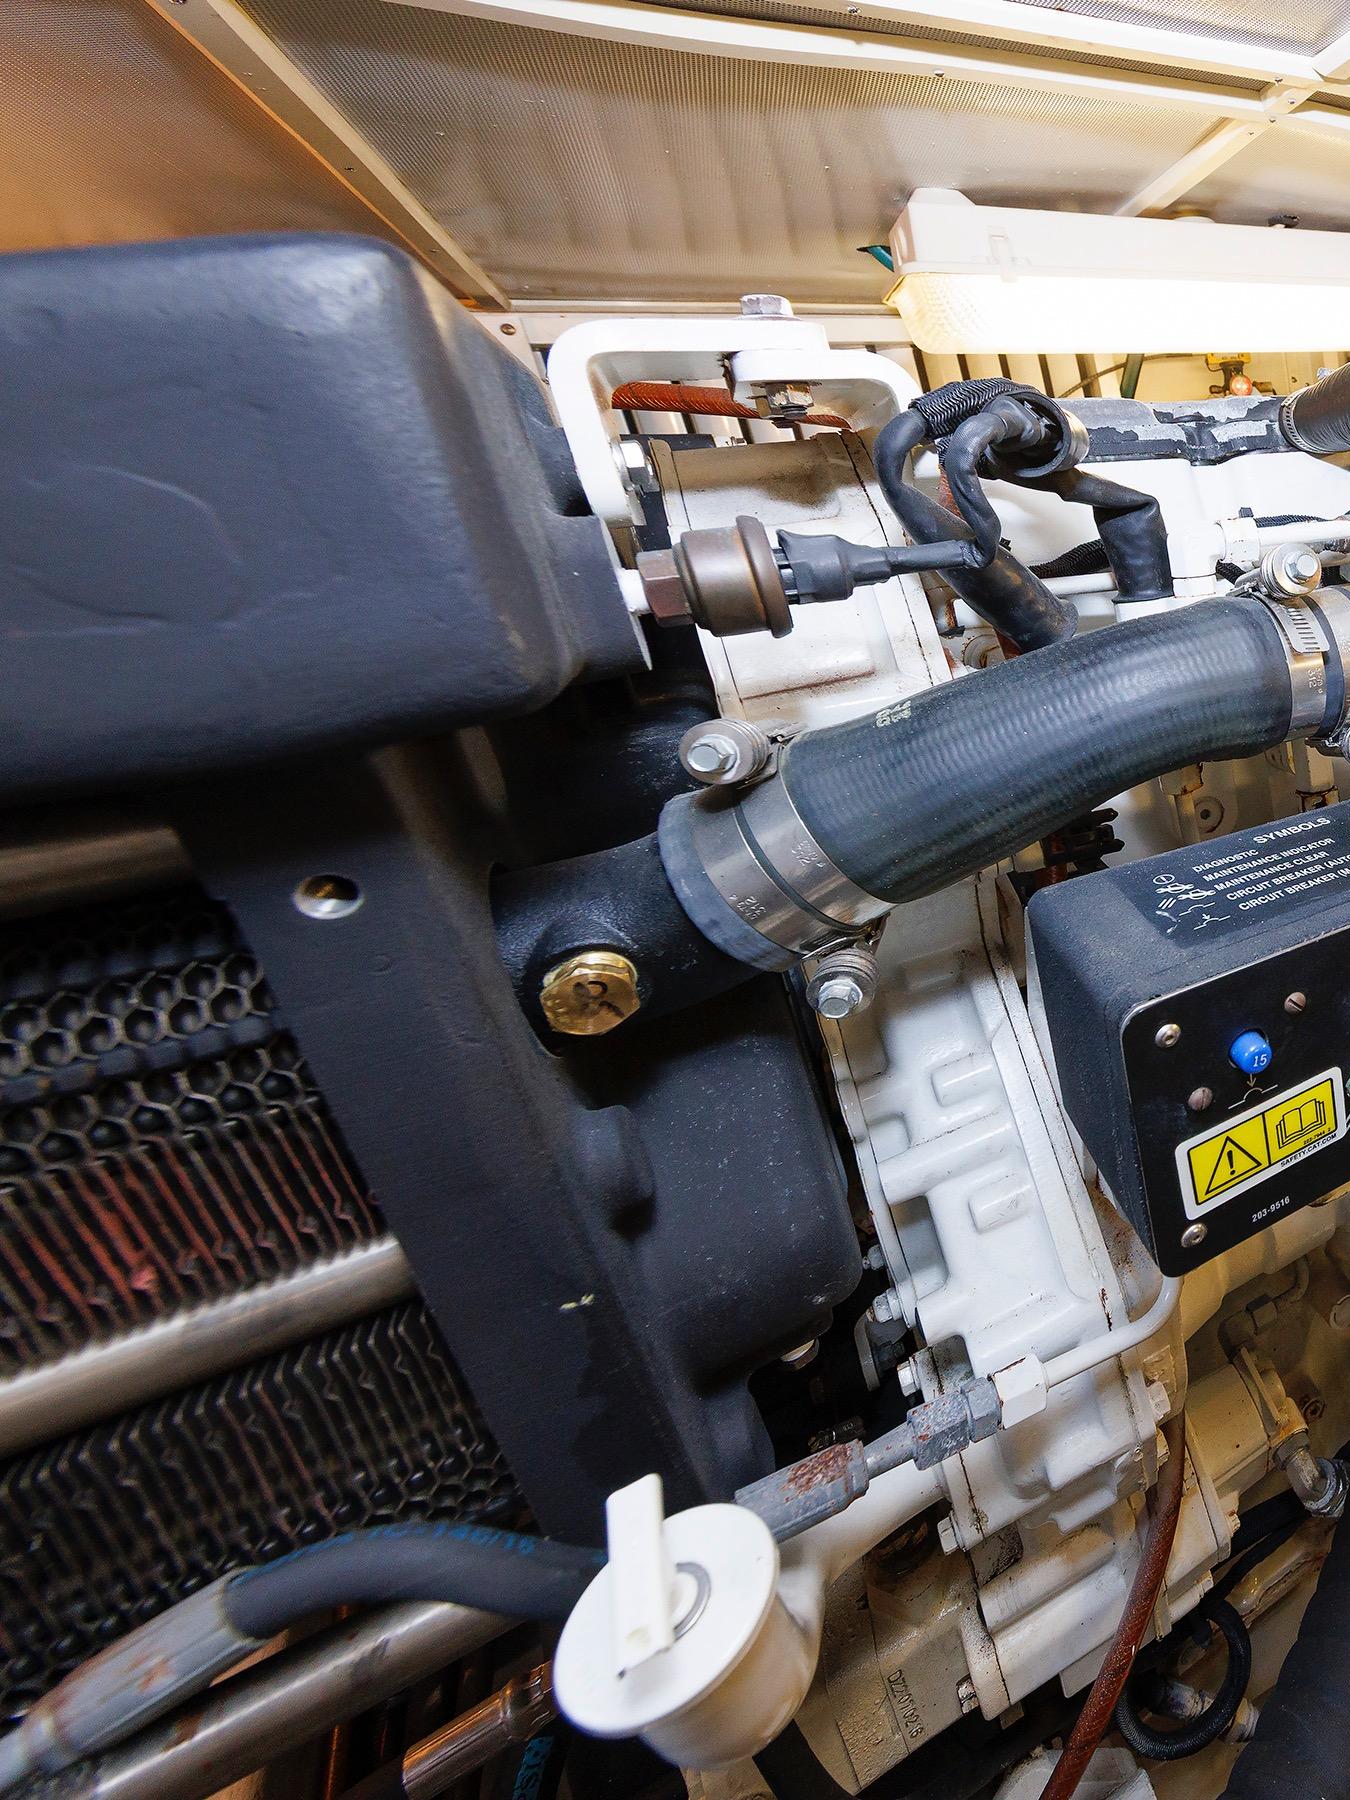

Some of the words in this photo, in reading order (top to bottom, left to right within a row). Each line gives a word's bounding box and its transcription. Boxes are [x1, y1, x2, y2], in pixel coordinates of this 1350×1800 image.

[1253, 817, 1331, 844] SYMBOLS
[1192, 849, 1259, 874] DIAGNOSTIC
[1202, 853, 1280, 882] MAINTENANCE
[1281, 837, 1336, 858] INDICATOR
[1213, 860, 1294, 892] MAINTENANCE
[1294, 851, 1330, 866] CLEAR
[1226, 879, 1274, 901] CIRCUIT
[1274, 863, 1324, 887] BREAKER
[1238, 890, 1286, 911] CIRCUIT
[1286, 872, 1340, 896] BREAKER
[1253, 1053, 1268, 1068] 15
[1280, 1132, 1337, 1168] SAFETY.CAT.COM
[1251, 1195, 1290, 1223] 203-9516
